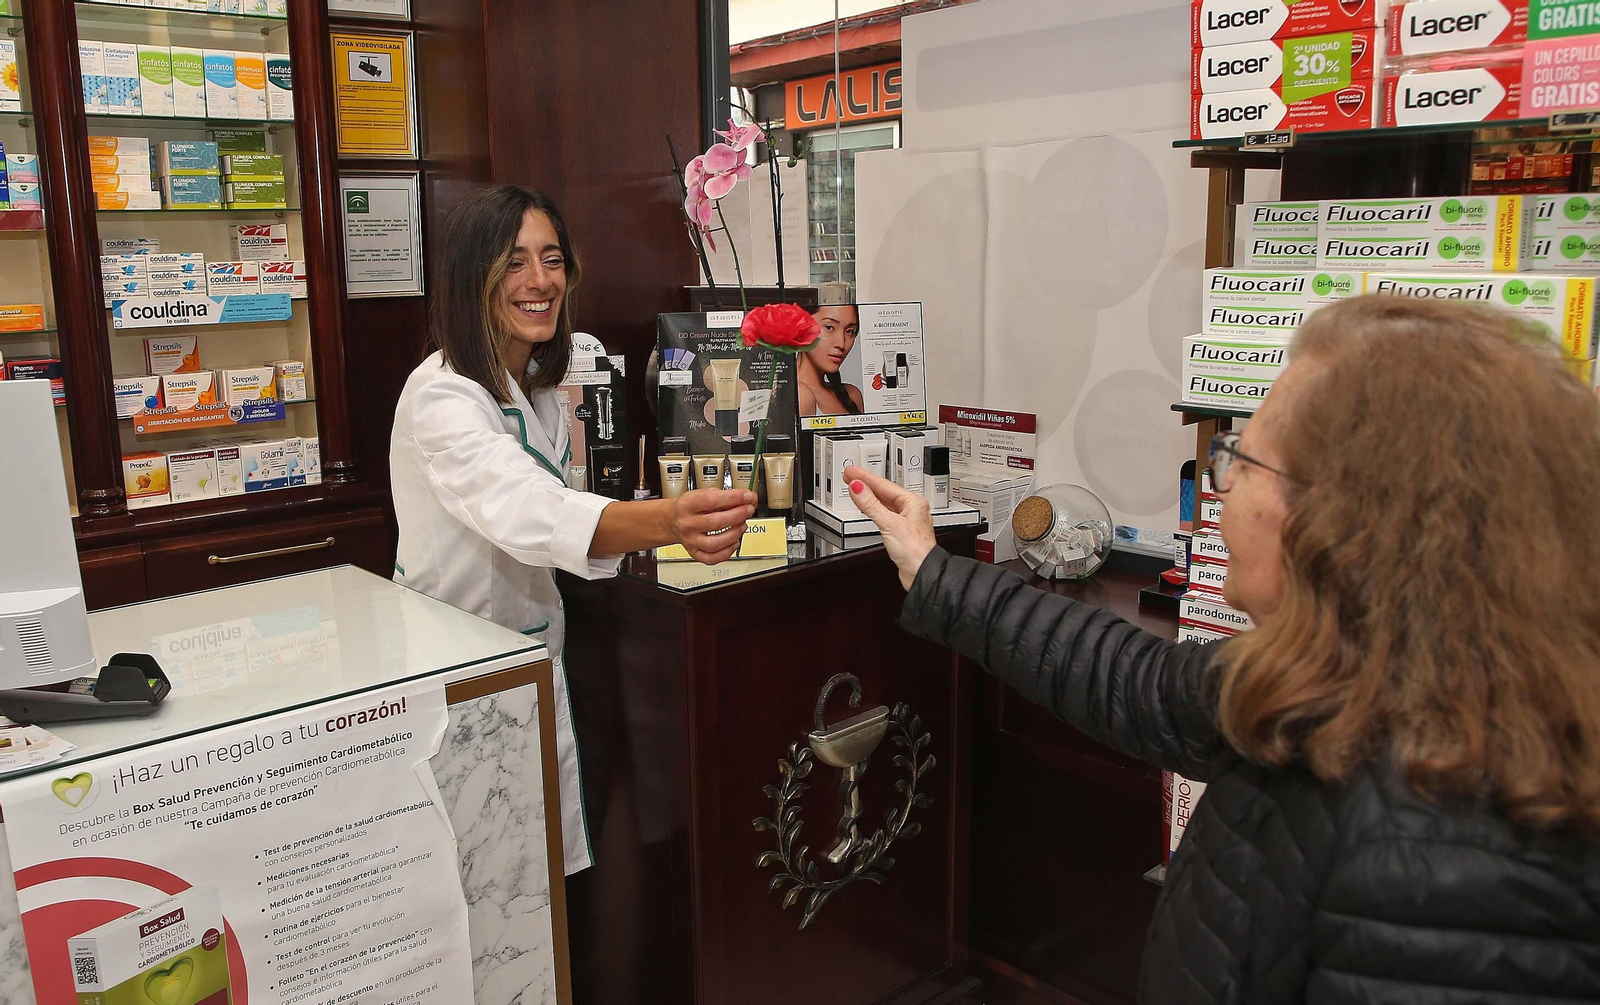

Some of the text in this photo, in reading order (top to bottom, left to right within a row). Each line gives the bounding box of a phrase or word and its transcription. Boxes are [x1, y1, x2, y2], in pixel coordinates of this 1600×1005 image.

[1208, 7, 1270, 30] Lacer
[1292, 5, 1328, 14] Antimicrobiana
[1292, 11, 1330, 20] Remineralizante
[1410, 12, 1488, 38] Lacer
[356, 42, 400, 50] VIDEOVIGILADA
[1304, 42, 1340, 54] UNIDAD
[140, 58, 169, 68] cinfatós
[173, 60, 202, 69] cinfatós
[205, 62, 233, 72] cinfatós
[1208, 56, 1270, 78] Lacer
[1294, 53, 1340, 77] 30%
[1534, 50, 1552, 66] UN
[1294, 77, 1338, 88] DESCUENTO
[1534, 66, 1580, 84] COLORS
[1405, 86, 1482, 110] Lacer
[1531, 82, 1599, 108] GRATIS
[1208, 104, 1269, 124] Lacer
[1290, 104, 1326, 112] Antimicrobiana
[1290, 110, 1328, 118] Remineralizante
[1326, 204, 1432, 221] Fluocaril
[1446, 205, 1483, 214] bi-fluoré
[1504, 199, 1514, 266] FORMATO AHORRO
[240, 238, 269, 246] couldina
[1325, 241, 1430, 256] Fluocaril
[1444, 243, 1480, 251] bi-fluoré
[152, 272, 179, 280] couldina
[210, 276, 241, 284] couldina
[1210, 276, 1305, 292] Fluocaril
[1317, 280, 1350, 288] bi-fluoré
[1376, 281, 1493, 300] Fluocaril
[1509, 287, 1551, 296] bi-fluoré
[130, 301, 208, 320] couldina
[1210, 308, 1304, 326] Fluocaril
[1573, 282, 1587, 355] FORMATO AHORRO
[153, 342, 182, 351] Strepsils
[1190, 344, 1284, 364] Fluocaril
[167, 380, 197, 388] Strepsils
[232, 375, 260, 384] Strepsils
[144, 407, 177, 416] Strepsils
[195, 402, 227, 411] Strepsils
[244, 398, 274, 407] Strepsils
[957, 410, 1016, 424] Minoxidil Viñas 5%
[1188, 604, 1248, 625] parodontax
[113, 696, 406, 793] ¡Haz un regalo a tu corazón!
[59, 732, 412, 835] Descubre la Box Salud Prevención y Seguimiento Cardiometabólico
[72, 747, 405, 847] en ocasión de nuestra Campaña de prevención Cardiometabólica
[184, 785, 317, 829] “Te cuidamos de corazón”
[263, 847, 280, 856] Test
[293, 830, 333, 849] prevención
[335, 826, 343, 834] de
[354, 816, 373, 827] salud
[264, 829, 367, 867] con consejos personalizados
[266, 852, 349, 882] Mediciones necesarias
[267, 883, 284, 895] para
[296, 867, 337, 884] evaluación
[269, 893, 303, 909] Medición
[325, 878, 351, 890] tensión
[353, 867, 379, 881] arterial
[381, 863, 397, 873] para
[398, 851, 433, 868] garantizar
[273, 923, 298, 936] Rutina
[299, 919, 308, 927] de
[311, 906, 344, 923] ejercicios
[346, 900, 361, 911] para
[372, 886, 404, 901] bienestar
[143, 913, 181, 934] Box Salud
[139, 923, 189, 950] PREVENCIÓN
[147, 932, 191, 956] SEGUIMIENTO
[138, 938, 195, 969] CARDIOMETABÓLICO
